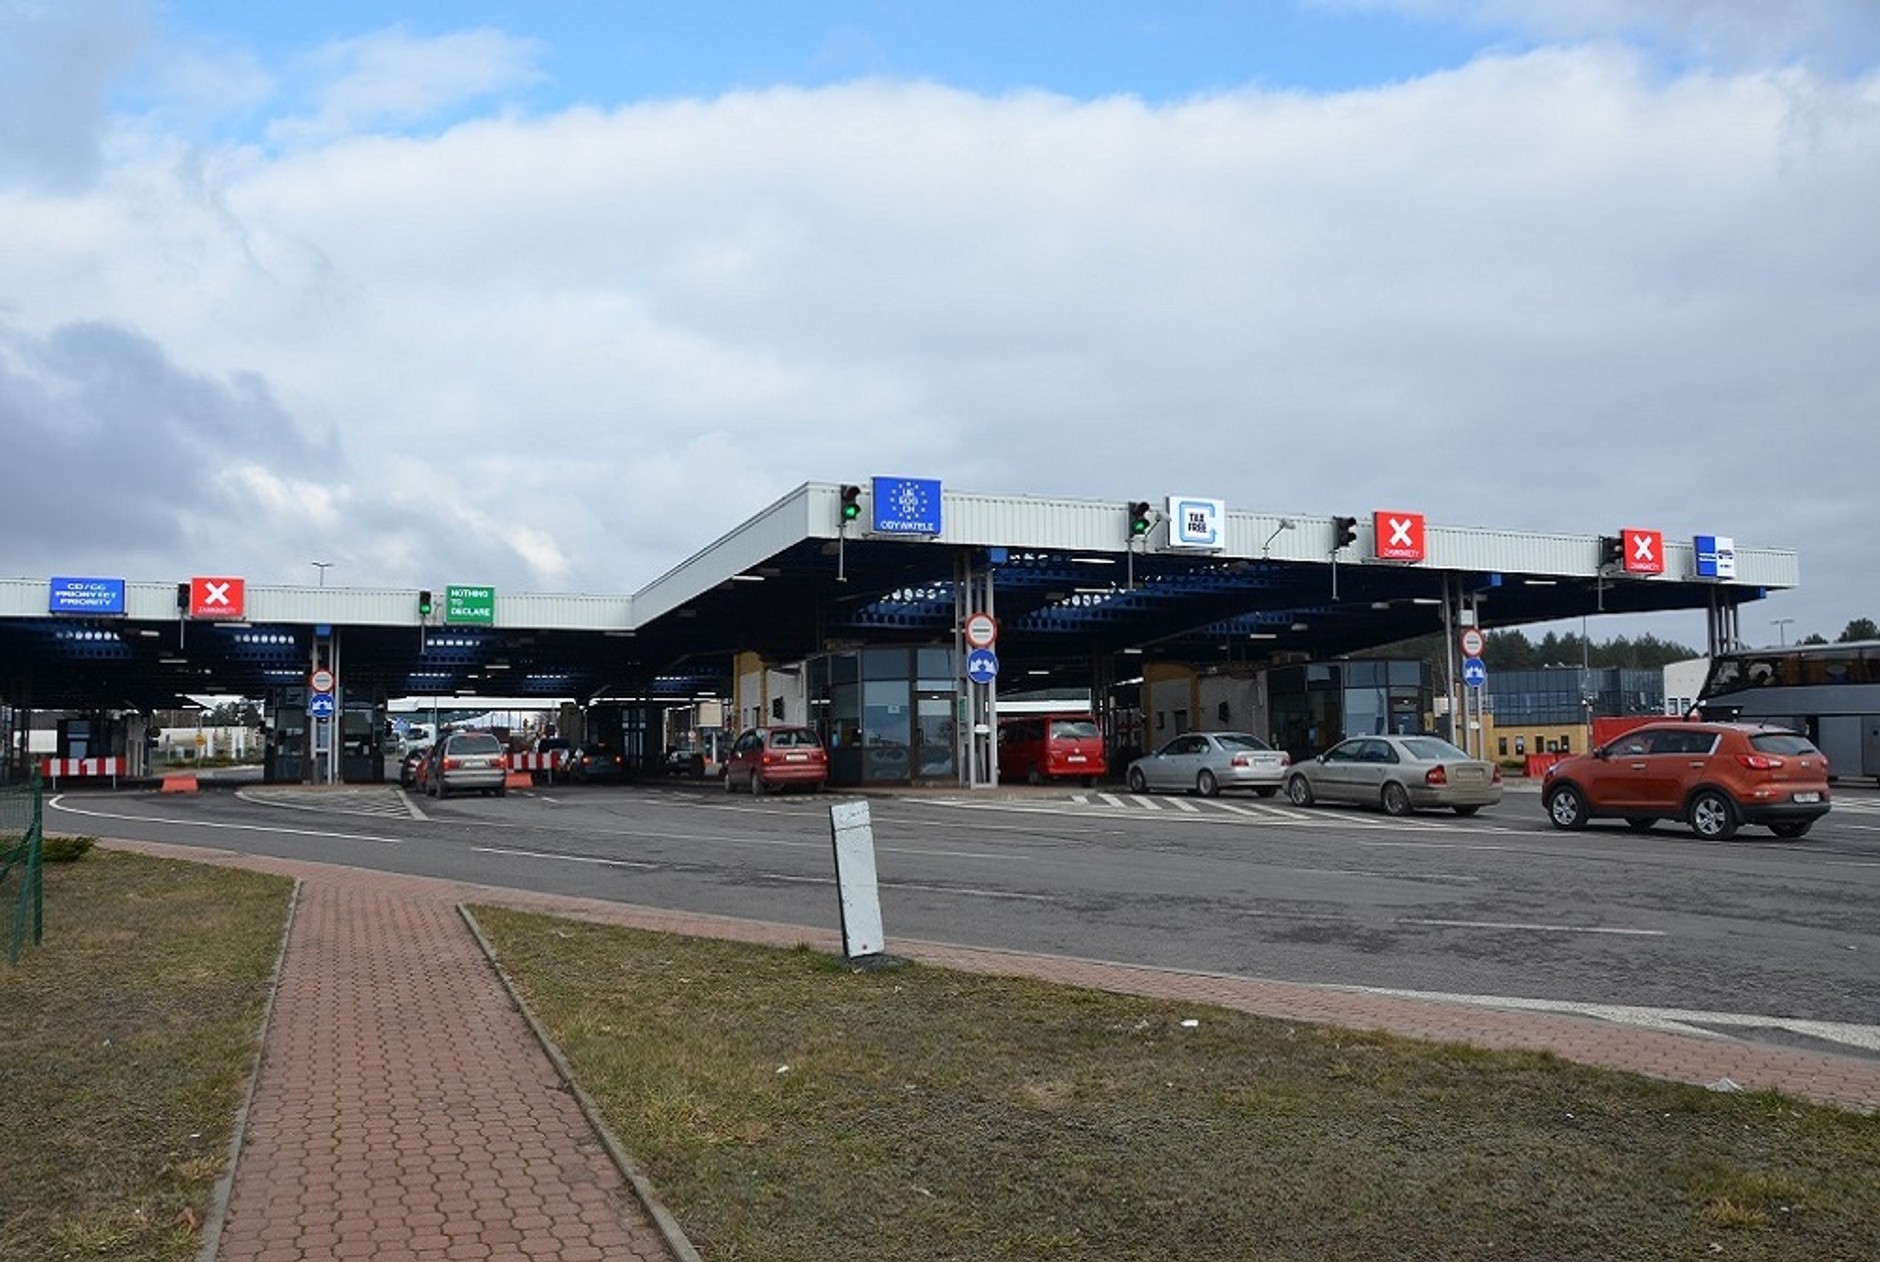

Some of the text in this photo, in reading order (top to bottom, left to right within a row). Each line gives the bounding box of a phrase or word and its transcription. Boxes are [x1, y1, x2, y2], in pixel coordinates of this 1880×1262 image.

[1189, 513, 1205, 522] TAX
[1188, 522, 1206, 533] FREE
[451, 589, 488, 598] NOTHING
[451, 598, 463, 606] TO
[451, 607, 490, 616] DECLARE
